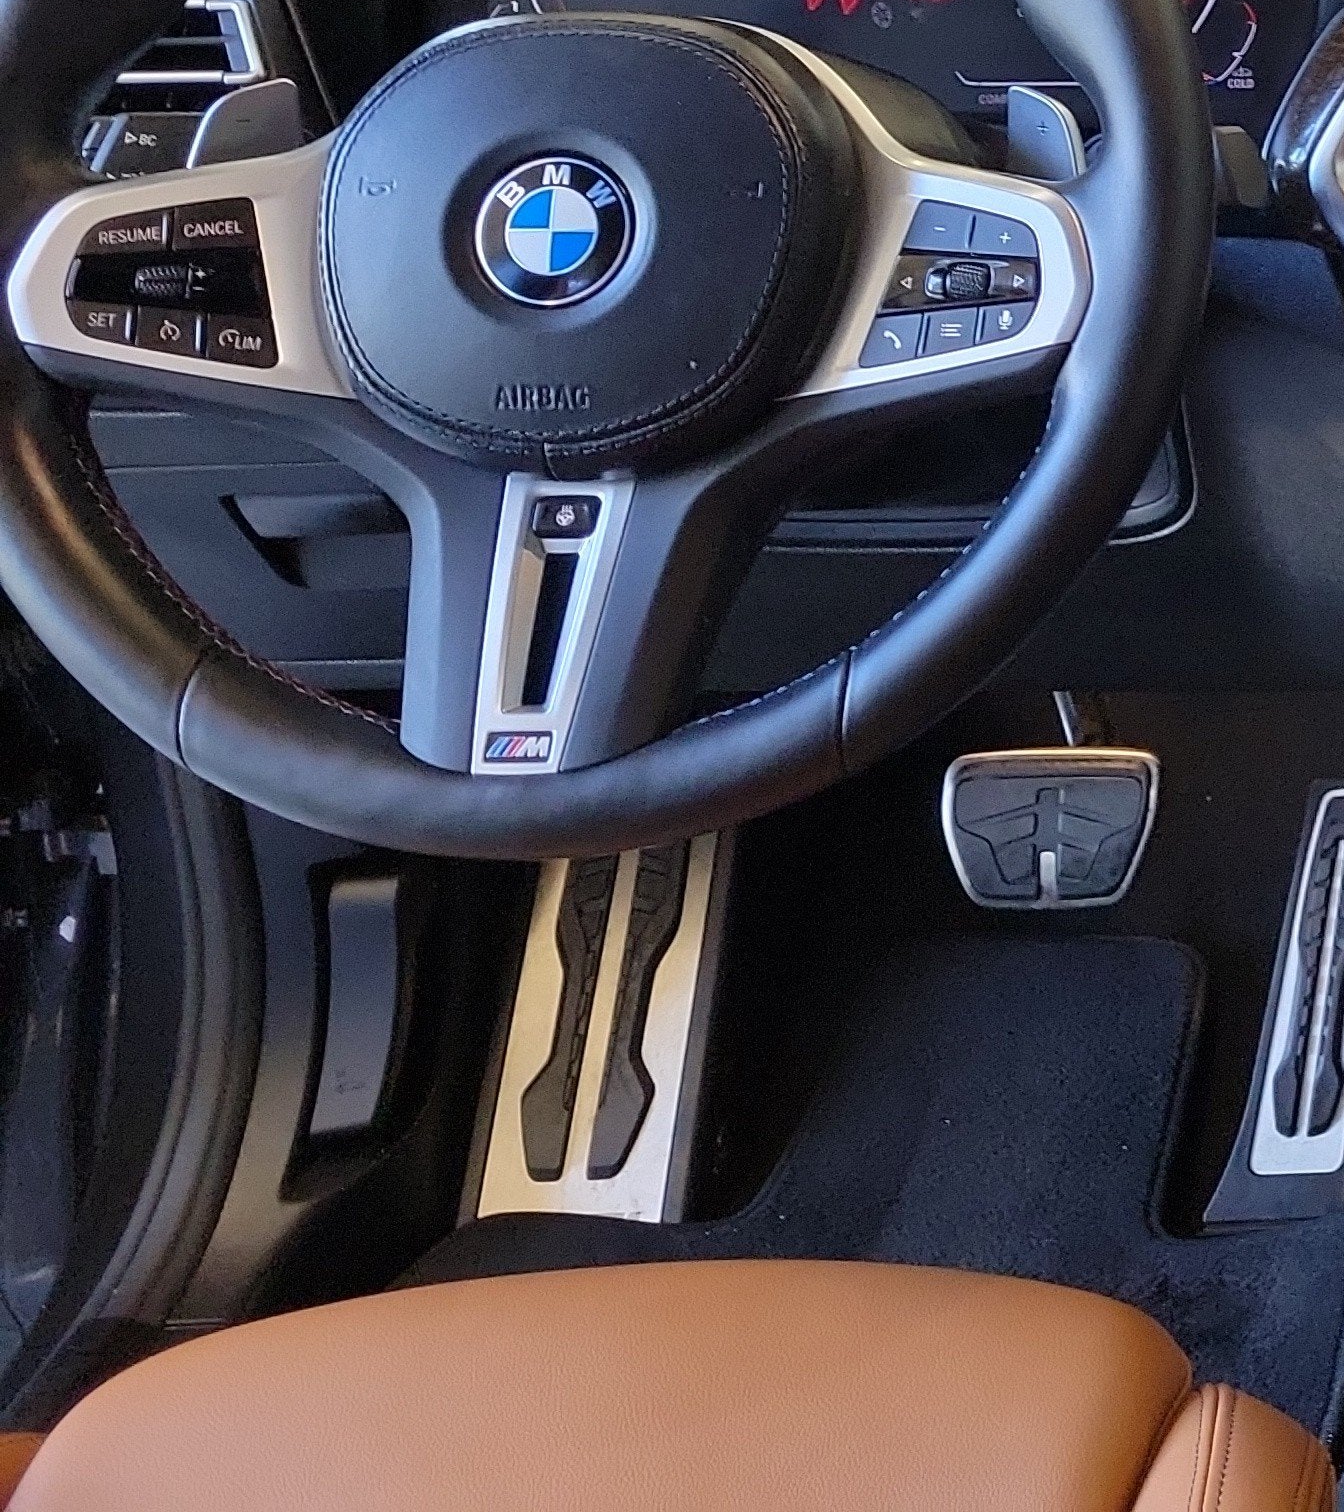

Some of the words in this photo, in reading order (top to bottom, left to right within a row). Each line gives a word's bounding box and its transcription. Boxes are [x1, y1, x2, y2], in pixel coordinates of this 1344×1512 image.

[496, 164, 616, 208] BMW
[98, 225, 161, 245] RESUME
[183, 219, 244, 238] CANCEL
[87, 312, 117, 328] SET
[234, 336, 263, 351] LIM
[495, 383, 591, 410] AIRBAG
